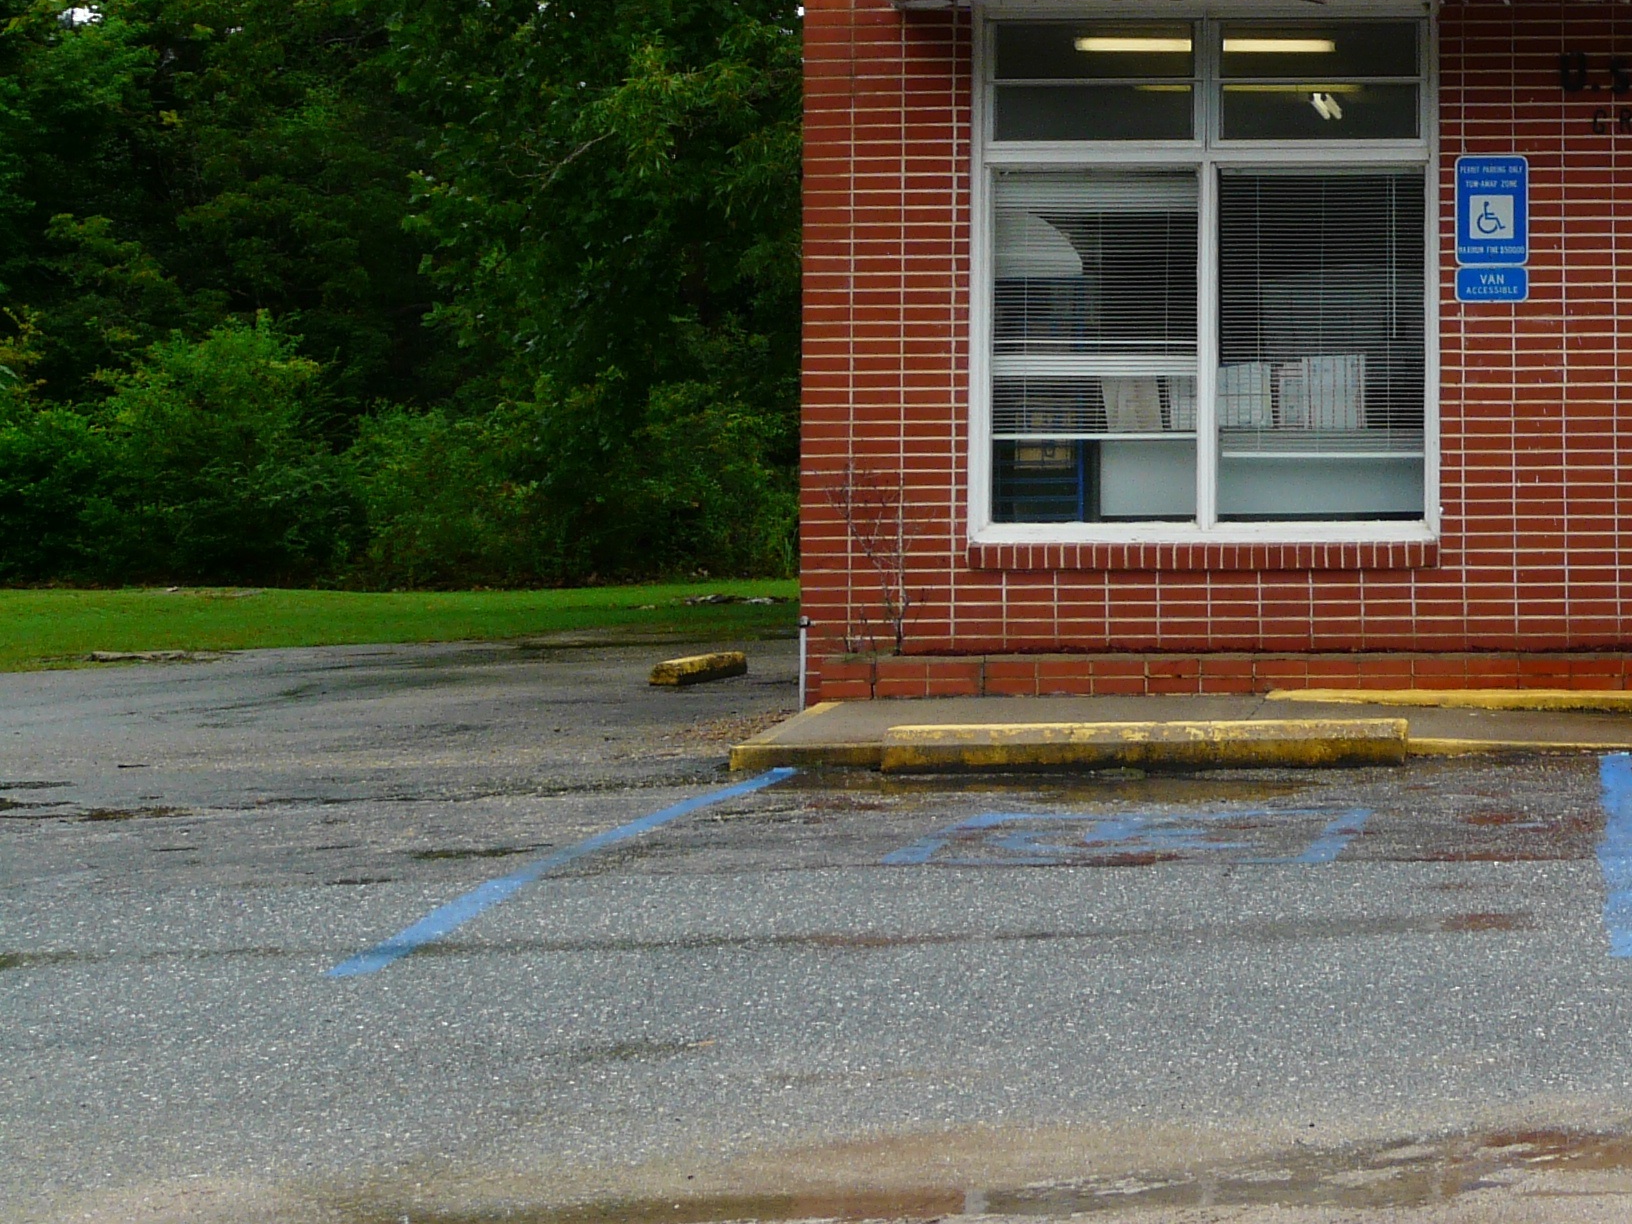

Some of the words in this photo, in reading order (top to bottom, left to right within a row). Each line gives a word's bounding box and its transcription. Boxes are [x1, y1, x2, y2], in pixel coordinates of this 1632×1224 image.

[1501, 179, 1518, 188] ZONE
[1480, 274, 1505, 285] VAN
[1466, 286, 1518, 295] ACCESSIBLE
